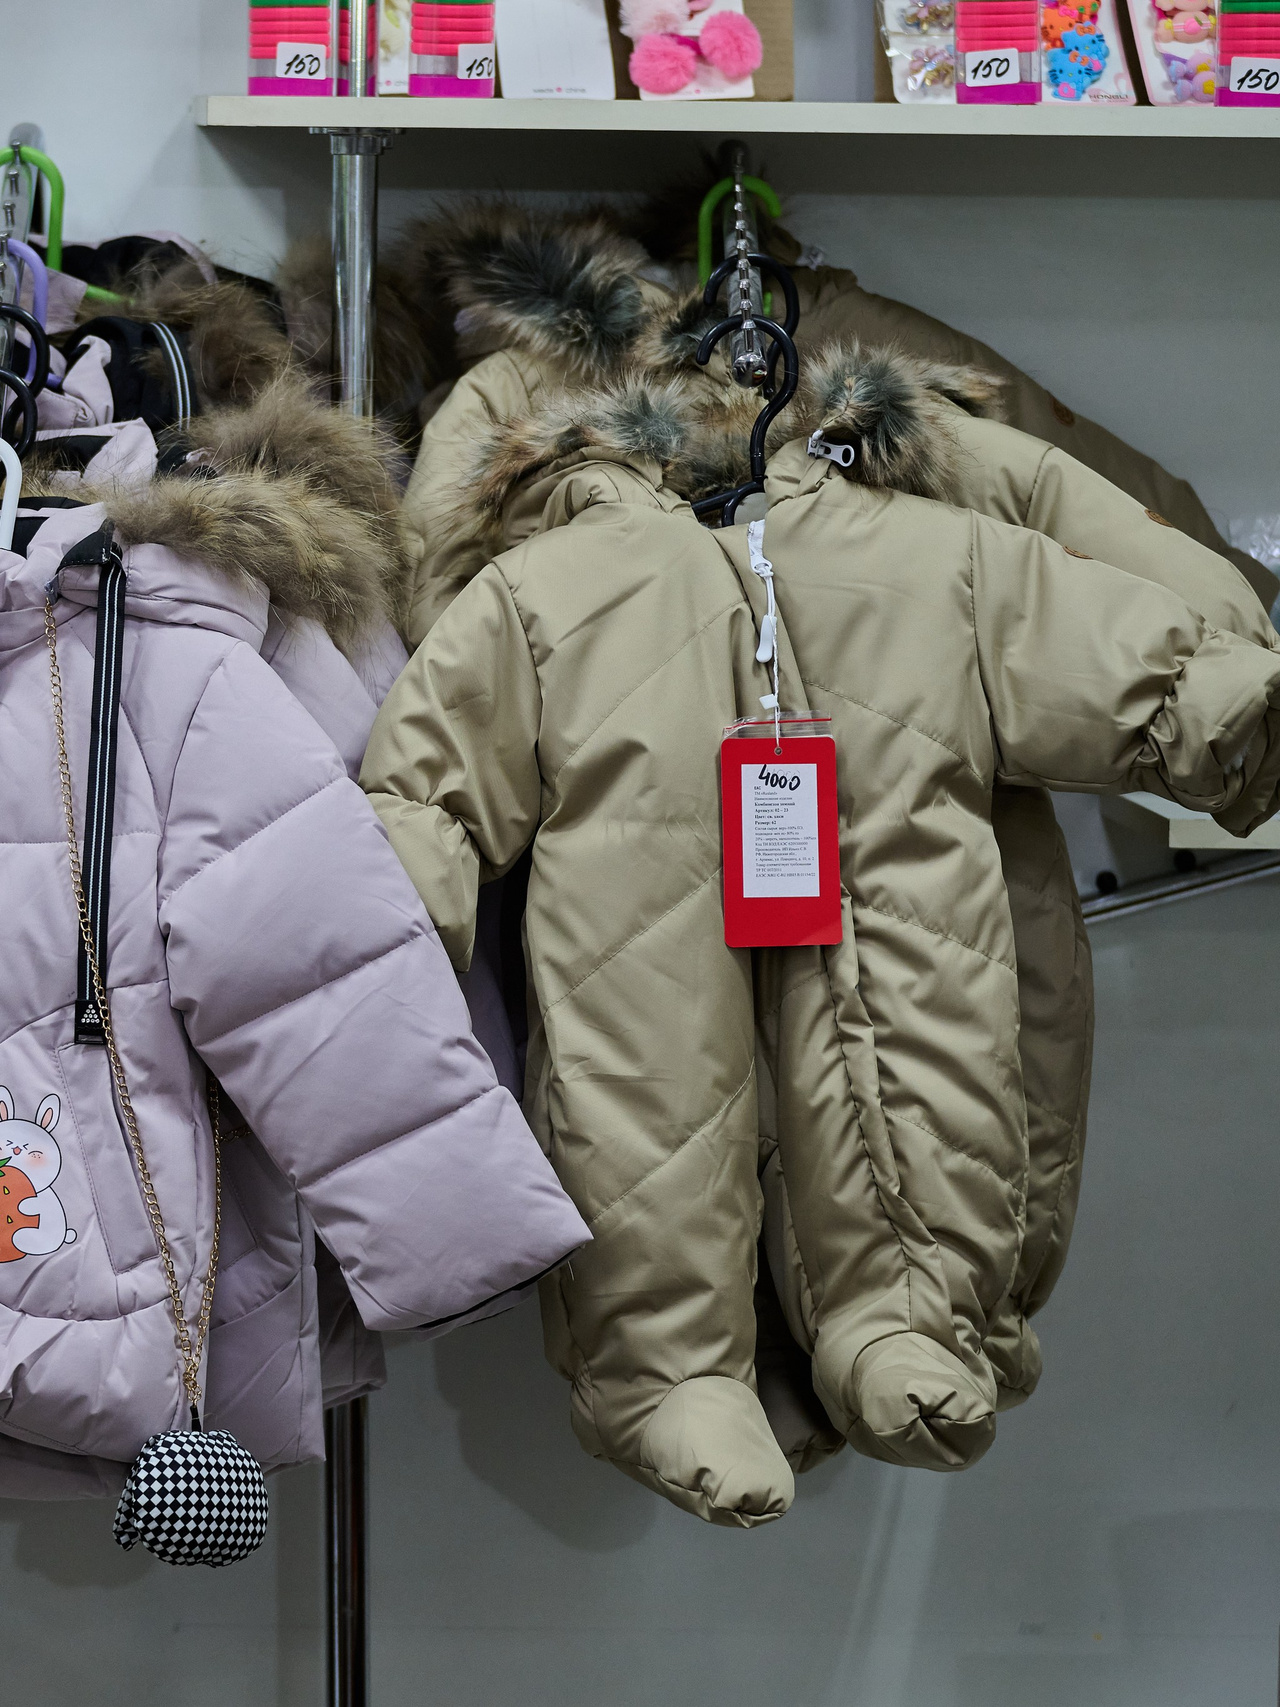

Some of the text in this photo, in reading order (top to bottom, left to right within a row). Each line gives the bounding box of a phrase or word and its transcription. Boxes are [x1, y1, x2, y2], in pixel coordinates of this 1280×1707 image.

[284, 54, 321, 76] 150
[466, 57, 493, 79] 150
[971, 57, 1010, 80] 150
[1237, 69, 1280, 91] 150
[758, 763, 801, 791] 4000
